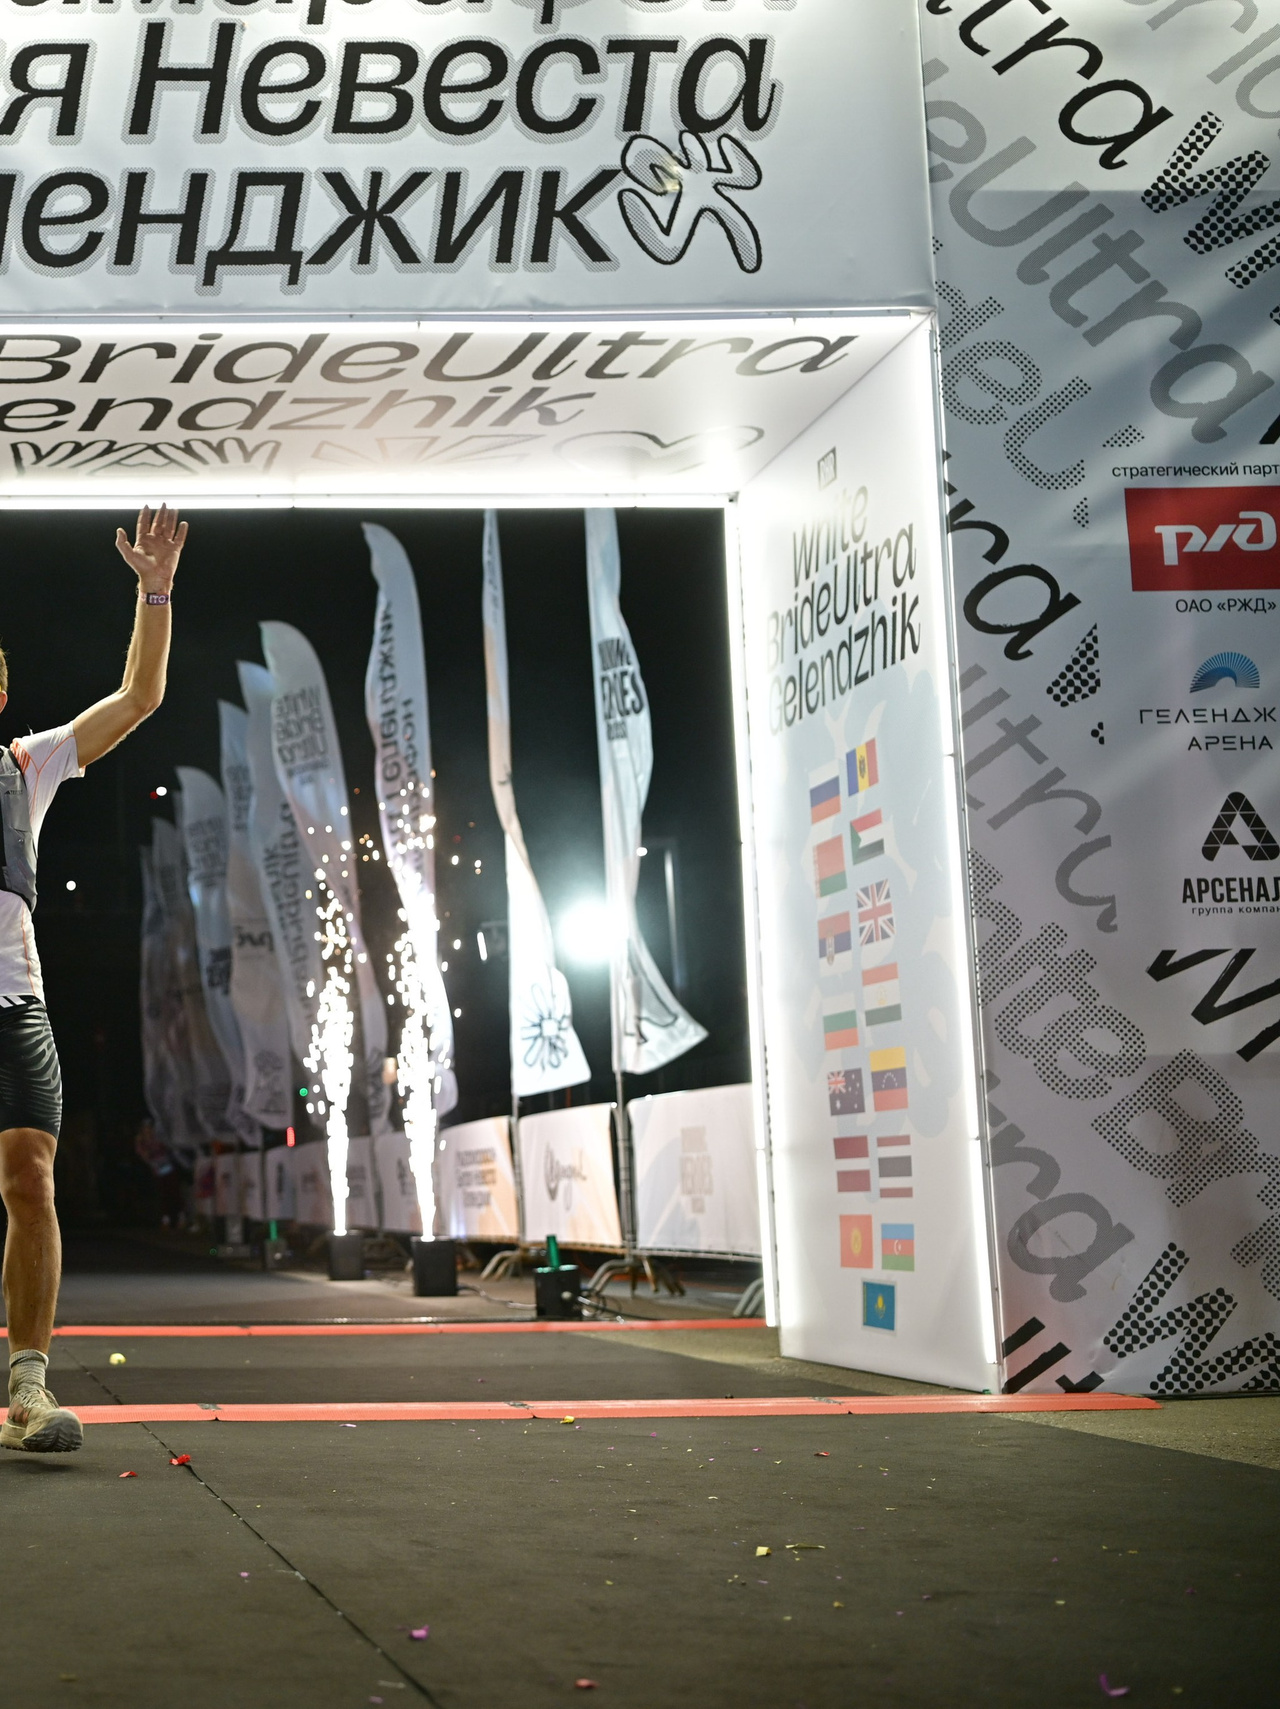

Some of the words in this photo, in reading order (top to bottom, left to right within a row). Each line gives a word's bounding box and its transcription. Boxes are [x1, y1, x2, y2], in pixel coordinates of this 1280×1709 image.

[128, 21, 777, 136] Невеста
[1111, 462, 1239, 480] стратегический
[1243, 464, 1280, 478] парт
[793, 485, 869, 588] White
[768, 523, 917, 673] BrideUltra
[1175, 598, 1212, 613] ОАО
[1217, 598, 1277, 614] «РЖД»
[769, 591, 921, 737] Gelendzhik
[1139, 707, 1277, 724] ГЕЛЕНДЖ
[1187, 735, 1273, 751] АРЕНА
[1192, 907, 1233, 917] группа
